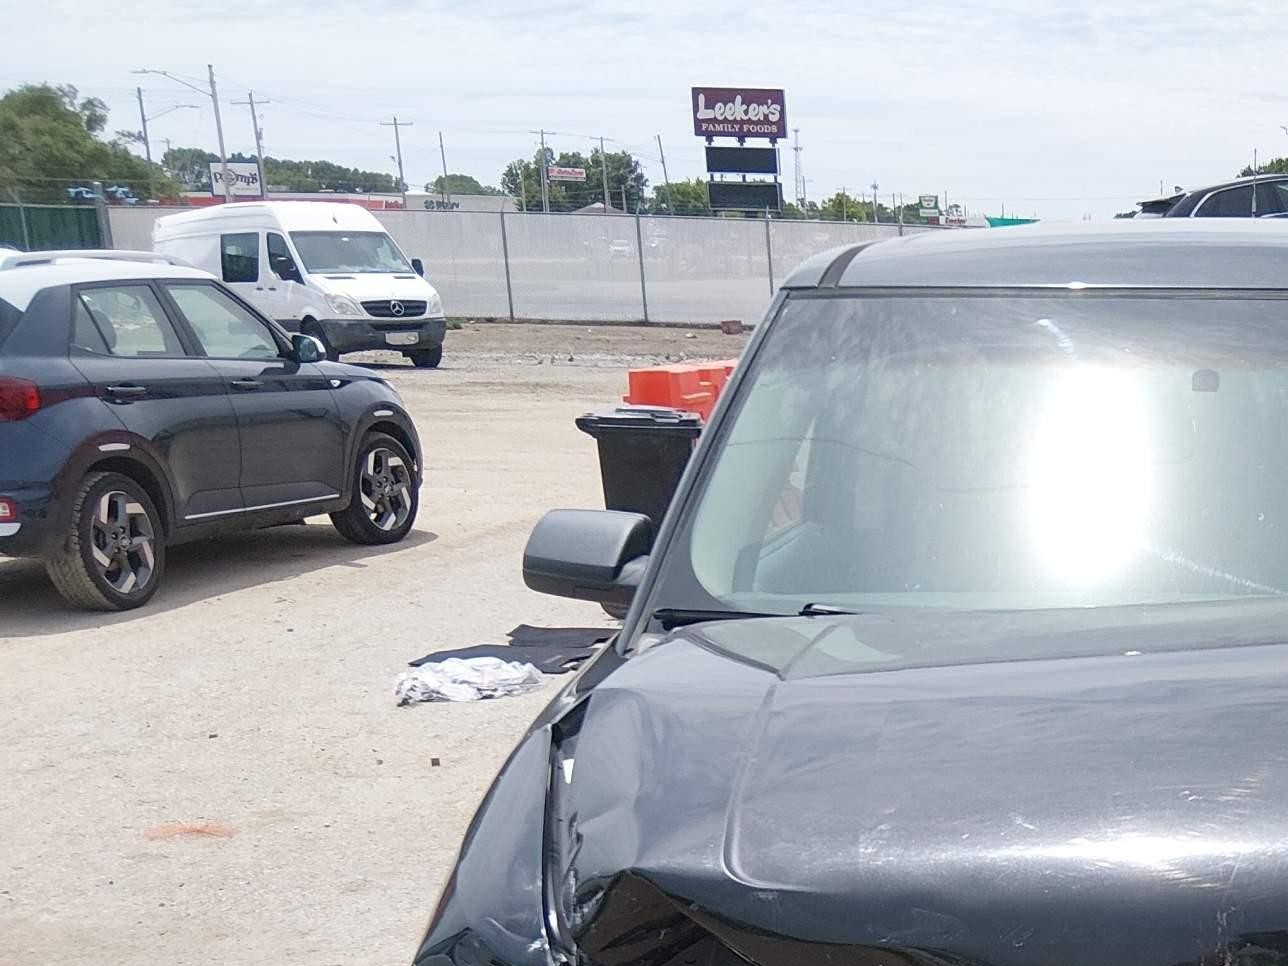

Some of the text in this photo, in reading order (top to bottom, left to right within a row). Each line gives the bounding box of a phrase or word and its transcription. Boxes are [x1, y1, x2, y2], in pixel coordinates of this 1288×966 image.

[697, 93, 780, 122] Leeker's
[701, 123, 778, 133] FAMILY FOODS
